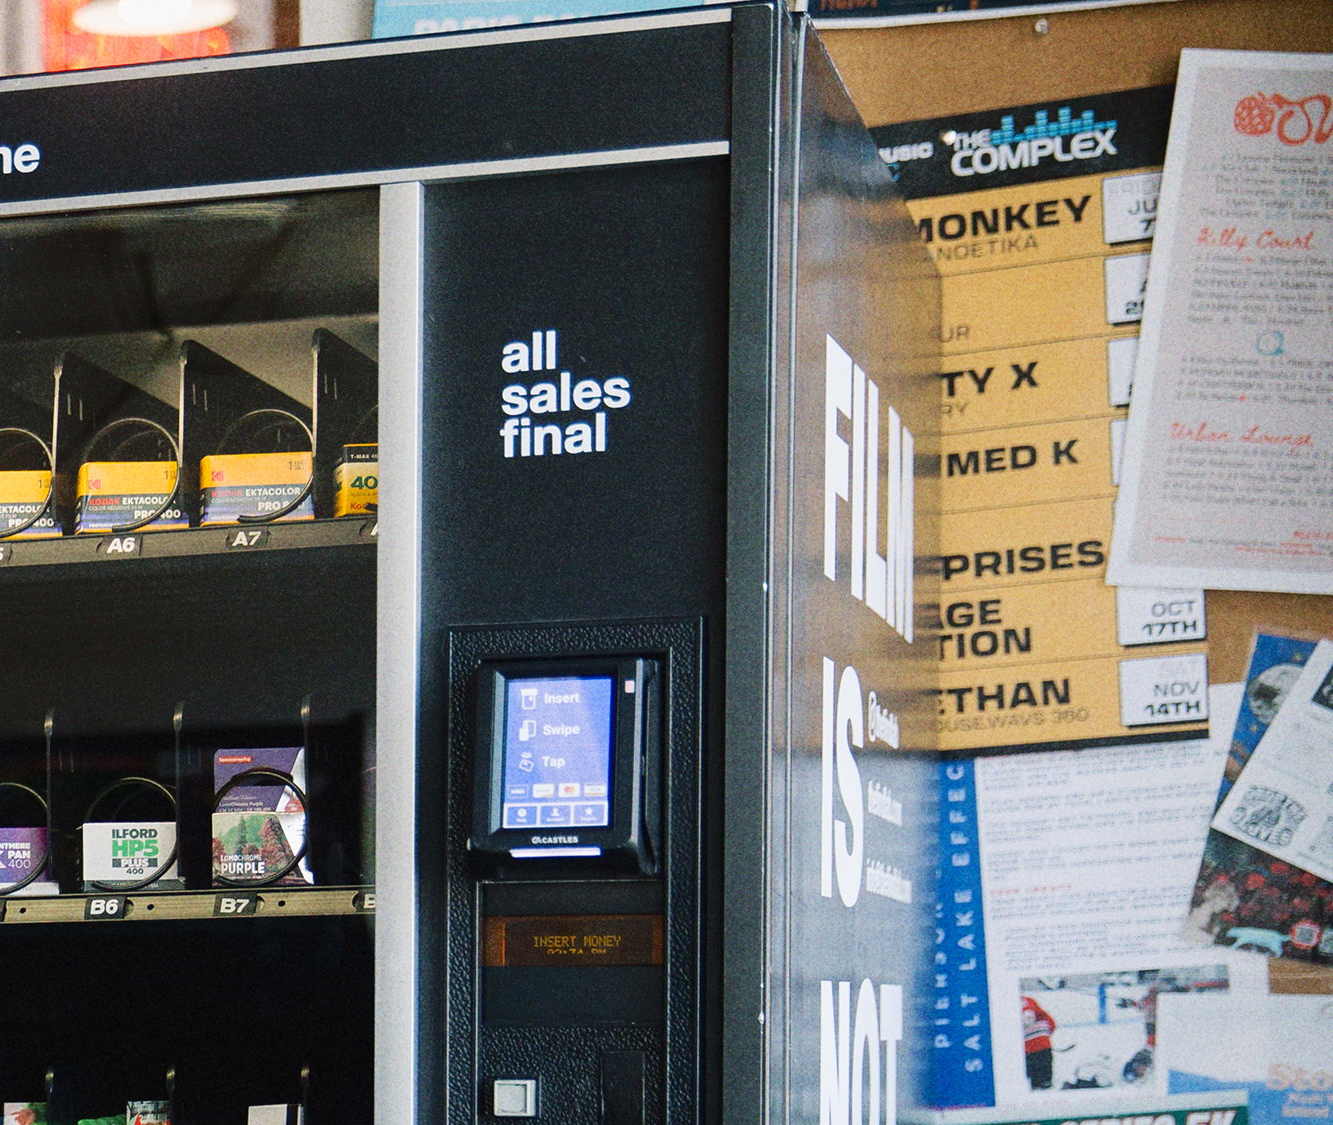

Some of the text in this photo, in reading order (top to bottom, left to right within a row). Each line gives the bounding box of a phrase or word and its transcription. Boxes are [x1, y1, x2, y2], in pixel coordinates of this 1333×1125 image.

[950, 129, 1118, 177] COMPLEX
[501, 330, 557, 373] all
[1011, 361, 1039, 390] X
[501, 371, 631, 416] sales
[499, 411, 606, 458] final
[1053, 440, 1080, 465] K
[245, 487, 301, 497] EKTACOLOR
[824, 333, 915, 644] FILM
[258, 502, 279, 511] PRO
[107, 537, 136, 554] A6
[232, 531, 262, 546] A7
[1150, 600, 1196, 617] OCT
[1141, 620, 1197, 637] 17TH
[1154, 681, 1199, 698] NOV
[544, 693, 580, 704] Insert
[1144, 701, 1200, 718] 14TH
[543, 724, 581, 738] Swipe
[542, 756, 565, 769] Tap
[820, 656, 864, 907] IS
[111, 828, 158, 838] ILFORD
[7, 851, 31, 859] PAN
[111, 839, 159, 857] HP5
[8, 859, 31, 869] 400
[120, 858, 150, 867] PLUS
[221, 862, 265, 873] PURPLE
[90, 899, 119, 915] B6
[219, 898, 249, 914] B7
[533, 935, 622, 948] INSERT MONEY
[954, 888, 985, 1073] SALT LAKE
